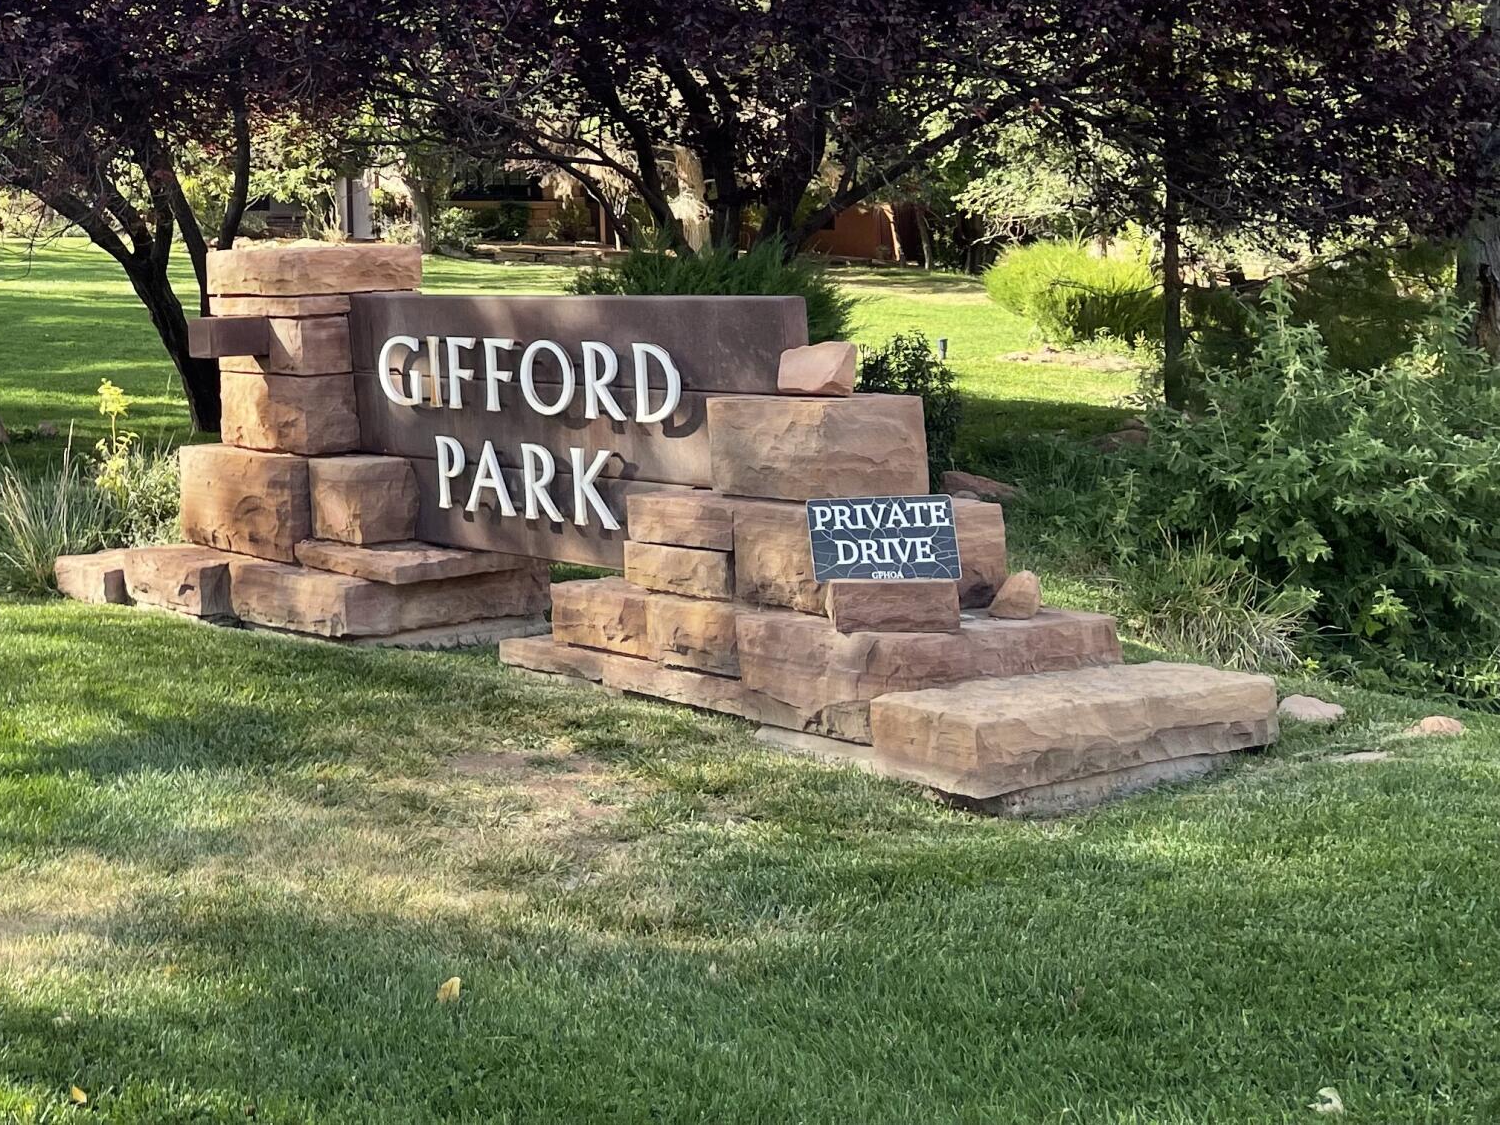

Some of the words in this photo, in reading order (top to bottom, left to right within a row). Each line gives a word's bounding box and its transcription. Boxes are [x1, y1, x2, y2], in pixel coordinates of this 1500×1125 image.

[378, 335, 682, 424] GIFFORD
[435, 435, 621, 531] PARK
[812, 501, 950, 530] PRIVATE
[834, 537, 936, 565] DRIVE
[871, 571, 904, 579] GPHOA
